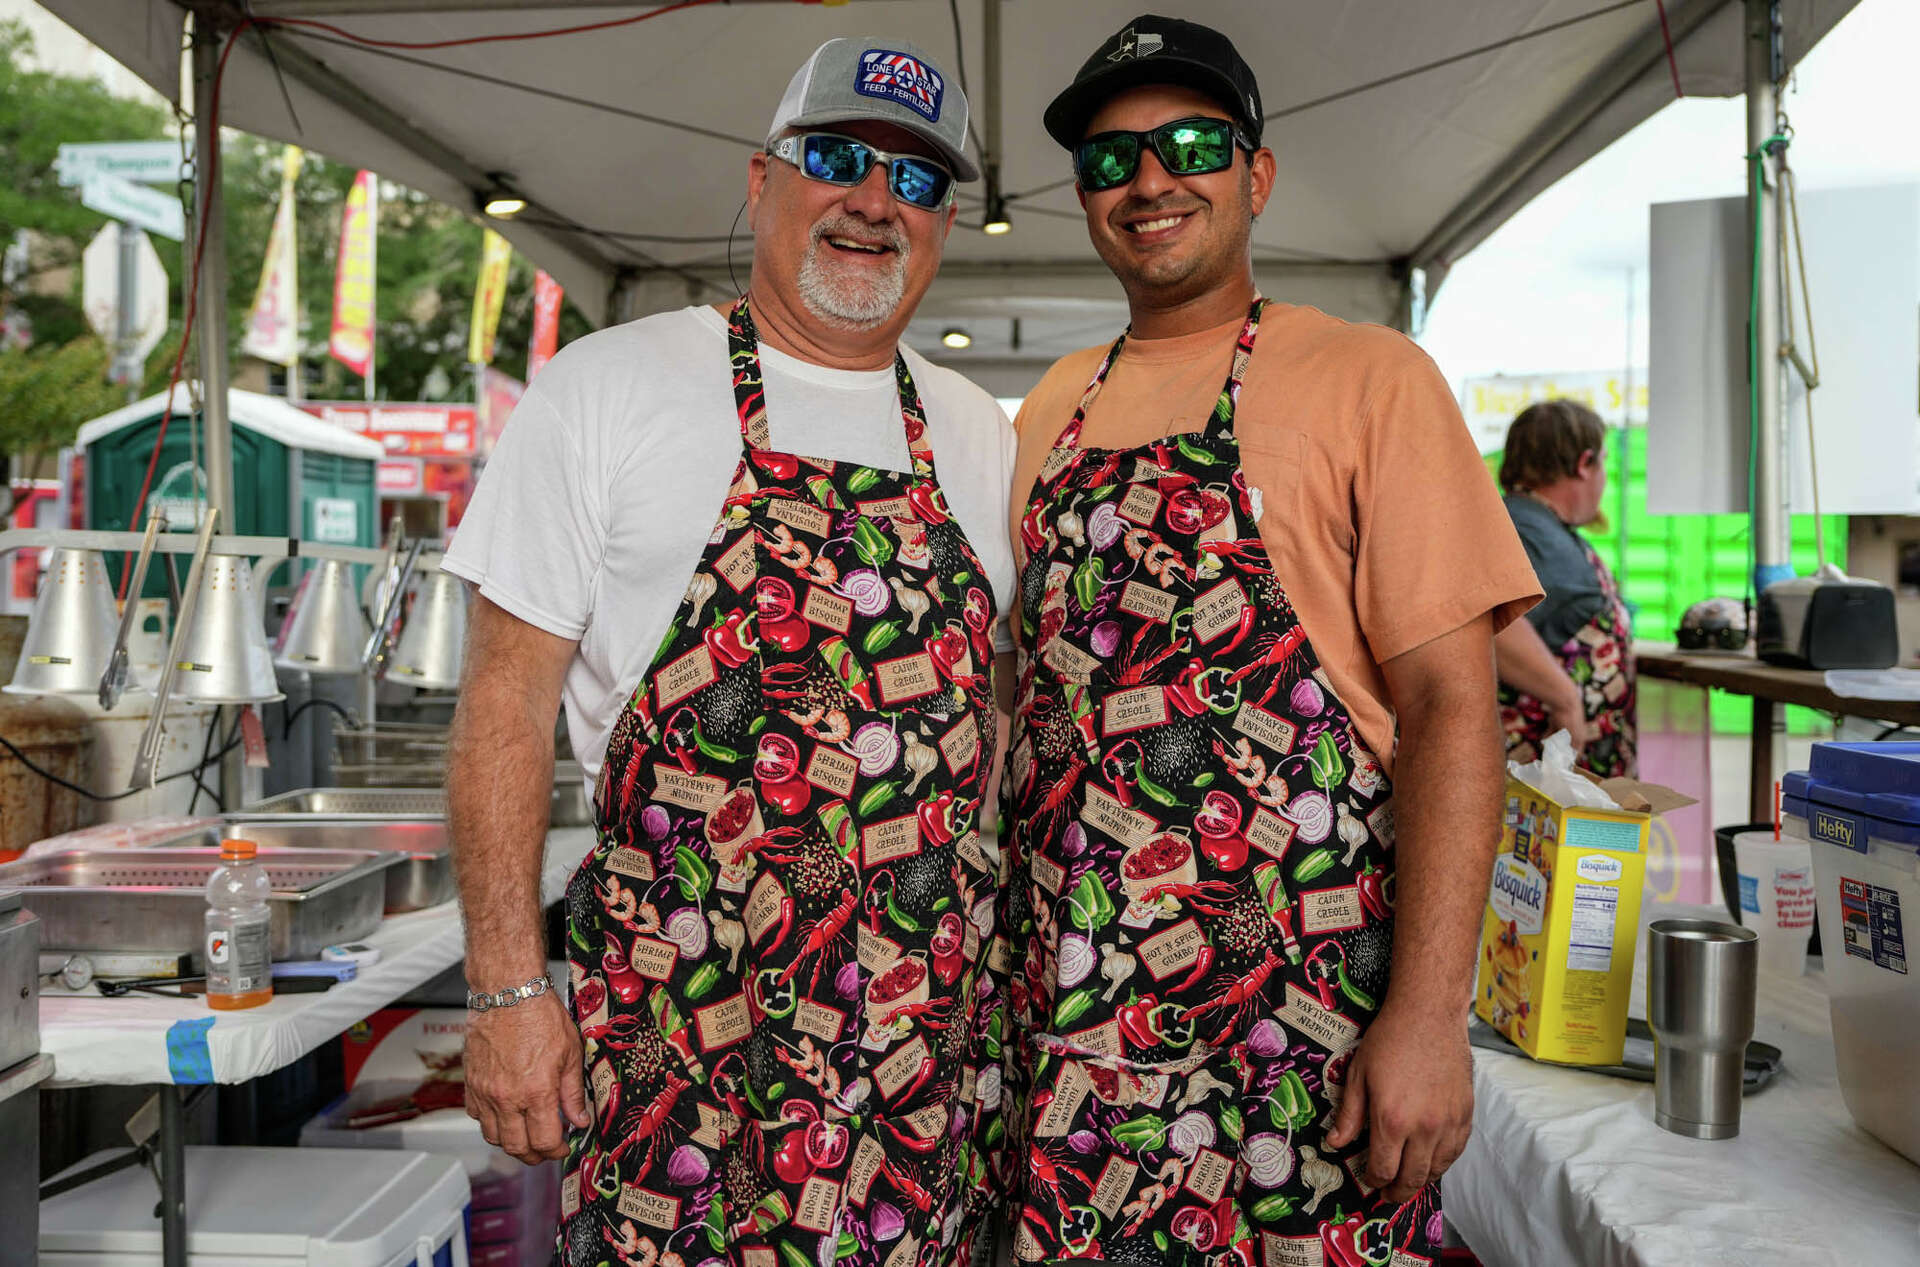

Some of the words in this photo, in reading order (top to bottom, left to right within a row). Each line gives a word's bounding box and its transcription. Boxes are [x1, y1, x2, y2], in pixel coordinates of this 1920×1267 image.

[866, 62, 892, 74] LONE
[916, 77, 937, 96] STAR
[864, 83, 887, 93] FEED
[893, 88, 933, 116] FERTILIZER
[1122, 501, 1152, 519] SHRIMP
[723, 561, 740, 579] HOT
[810, 591, 849, 614] SHRIMP
[1218, 587, 1242, 608] SPICY
[808, 606, 844, 626] BISQUE
[1208, 606, 1238, 629] GUMBO
[669, 656, 696, 679] CAJUN
[892, 660, 919, 675] CAJUN
[668, 667, 700, 691] CREOLE
[893, 672, 925, 688] CREOLE
[1117, 692, 1147, 706] CAJUN
[1115, 703, 1151, 720] CREOLE
[1245, 704, 1291, 735] CRAWFISH
[1242, 717, 1284, 747] LOUSIANA
[815, 752, 855, 774] SHRIMP
[664, 773, 716, 793] JAMBALAYA
[811, 768, 849, 790] BISQUE
[1096, 797, 1145, 830] JAMBALAYA
[878, 823, 904, 837] CAJUN
[1255, 814, 1290, 838] SHRIMP
[1818, 815, 1853, 847] Hefty
[877, 835, 906, 850] CREOLE
[1251, 830, 1281, 851] BISQUE
[757, 883, 779, 908] SPICY
[1494, 860, 1542, 911] Bisquick
[1845, 882, 1863, 898] Hefty
[1318, 893, 1345, 905] CAJUN
[1316, 906, 1350, 919] CREOLE
[635, 943, 674, 960] SHRIMP
[1143, 947, 1162, 962] HOT
[1174, 927, 1200, 946] SPICY
[634, 958, 666, 974] BISQUE
[1162, 946, 1194, 967] GUMBO
[715, 1003, 739, 1019] CAJUN
[1296, 997, 1347, 1034] JAMBALAYA
[715, 1015, 745, 1033] CREOLE
[1296, 1014, 1334, 1041] JUMPIN'
[1077, 1029, 1105, 1045] CAJUN
[879, 1068, 894, 1083] HOT
[904, 1043, 926, 1064] SPICY
[891, 1059, 919, 1085] GUMBO
[1045, 1073, 1073, 1129] JAMBALAYA
[914, 1112, 933, 1133] UMBO
[858, 1152, 883, 1196] CRAWFISH
[1193, 1153, 1216, 1190] SHRIMP
[1205, 1162, 1227, 1197] BISQUE
[1094, 1161, 1120, 1205] CRAWFISH
[624, 1186, 671, 1211] CRAWFISH
[804, 1183, 821, 1220] BISQUE
[818, 1185, 835, 1228] SHRIMP
[623, 1199, 667, 1225] LOUSIANA
[1274, 1240, 1305, 1253] CAJUN
